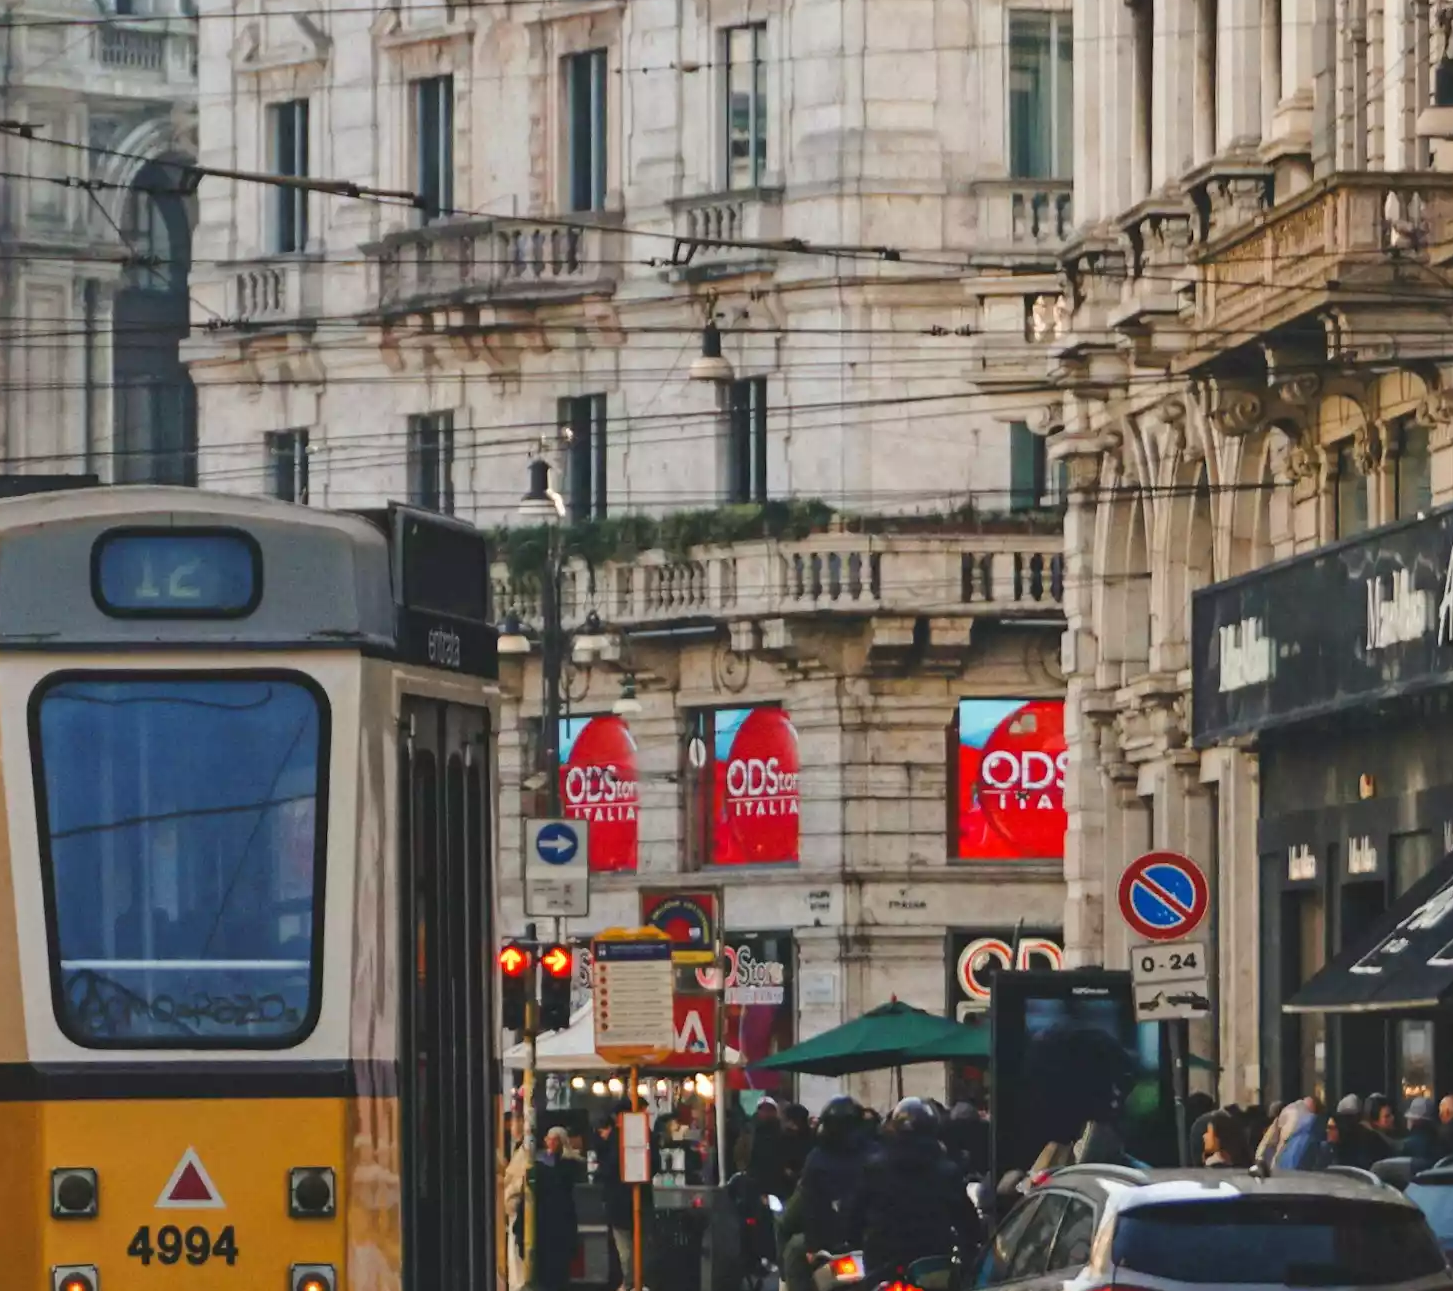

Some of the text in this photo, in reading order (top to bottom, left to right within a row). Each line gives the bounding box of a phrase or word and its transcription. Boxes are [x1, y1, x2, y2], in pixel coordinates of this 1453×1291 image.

[574, 806, 636, 823] ITALIA
[736, 799, 798, 816] ITALIA
[1169, 952, 1198, 970] 24
[127, 1224, 240, 1266] 4994
